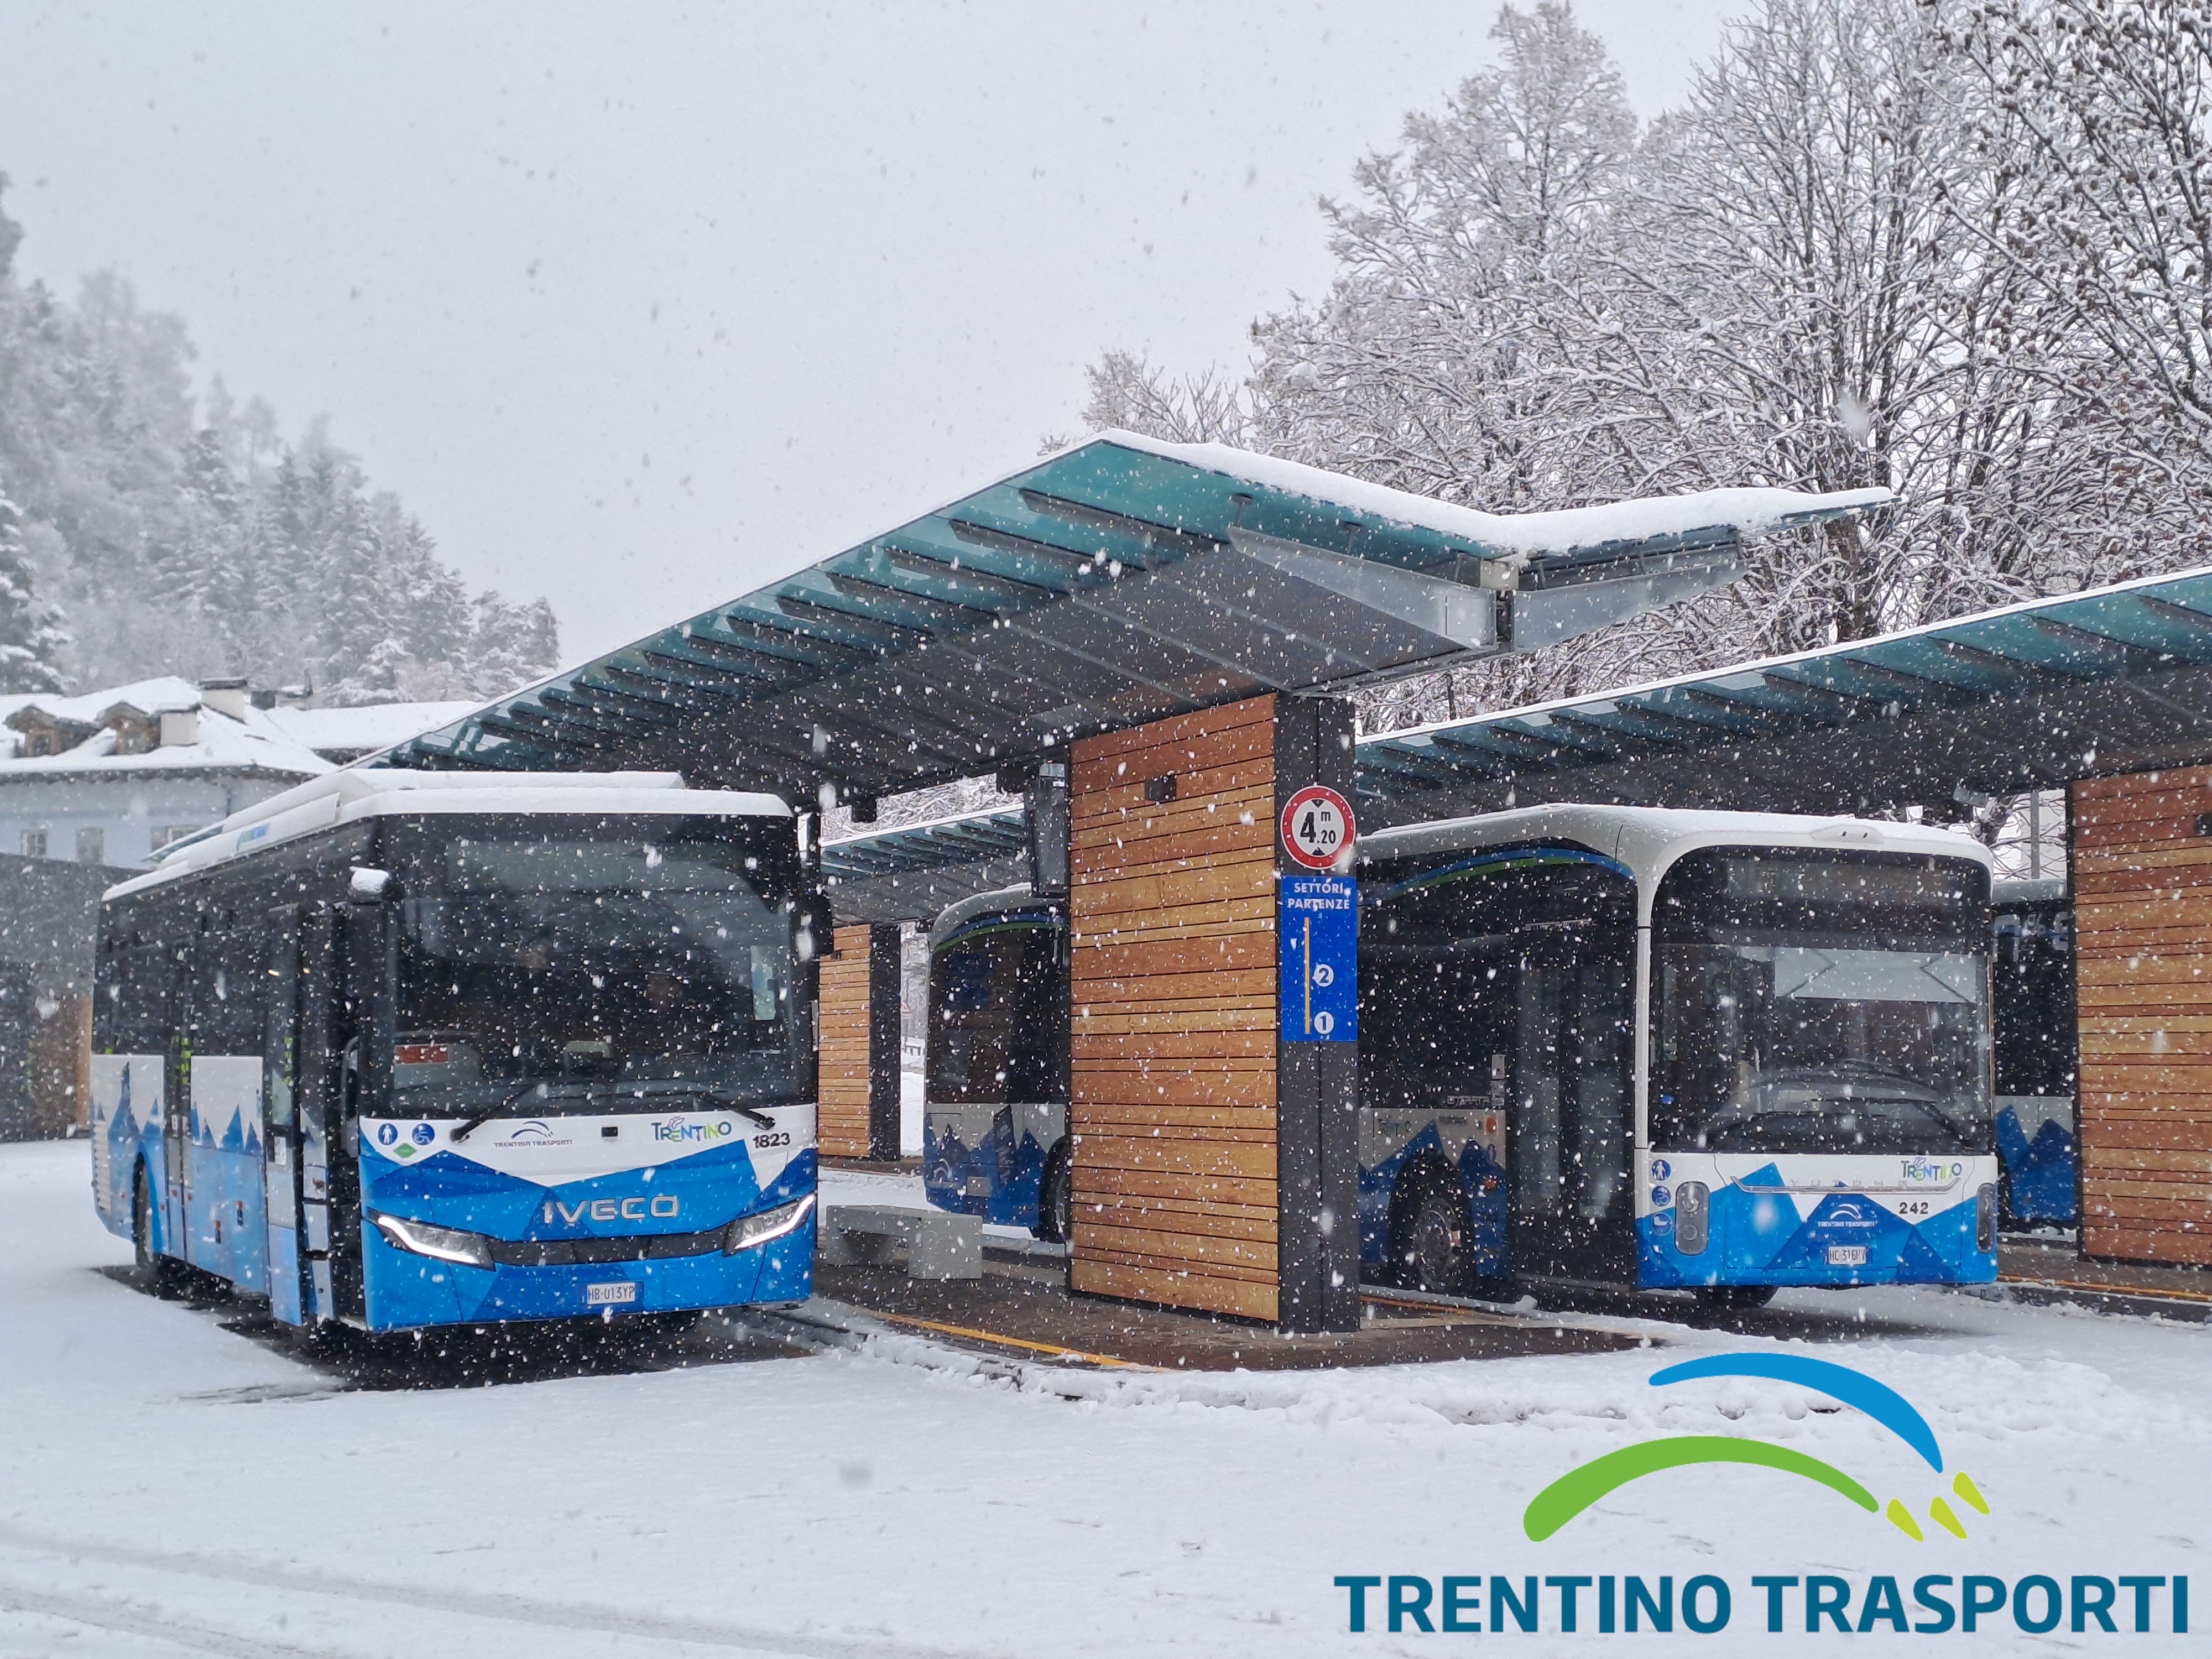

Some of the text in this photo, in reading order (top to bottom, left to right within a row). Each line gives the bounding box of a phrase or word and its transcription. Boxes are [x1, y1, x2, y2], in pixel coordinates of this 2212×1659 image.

[1293, 881, 1344, 894] SETTORI
[1287, 897, 1350, 910] PARTENZE
[1318, 968, 1329, 983] 2
[1319, 1015, 1328, 1031] 1
[651, 1121, 732, 1142] TRENTINO
[753, 1133, 790, 1149] 1823
[1901, 1160, 1962, 1181] TRENTINO
[544, 1195, 678, 1226] IVECO
[1899, 1202, 1928, 1214] 242
